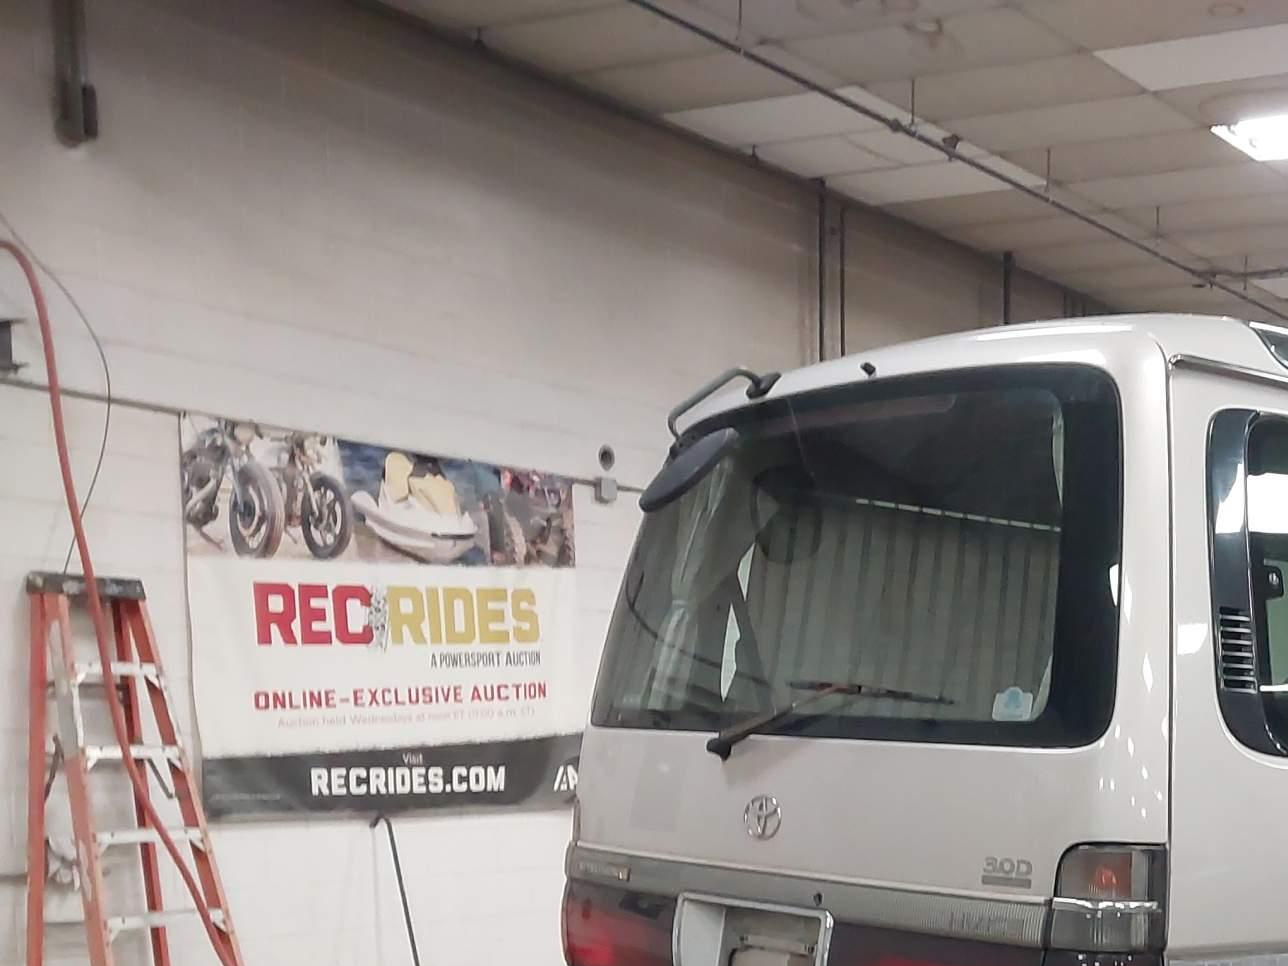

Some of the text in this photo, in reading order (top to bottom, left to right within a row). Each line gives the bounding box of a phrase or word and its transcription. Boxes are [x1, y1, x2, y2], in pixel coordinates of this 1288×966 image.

[253, 583, 540, 645] REC RIDES
[430, 650, 541, 668] A POWERSPORT AUCTION
[253, 682, 548, 711] ONLINE-EXCLUSIVE AUCTION
[402, 752, 424, 766] Visit
[310, 765, 505, 797] RECRIDES.COM
